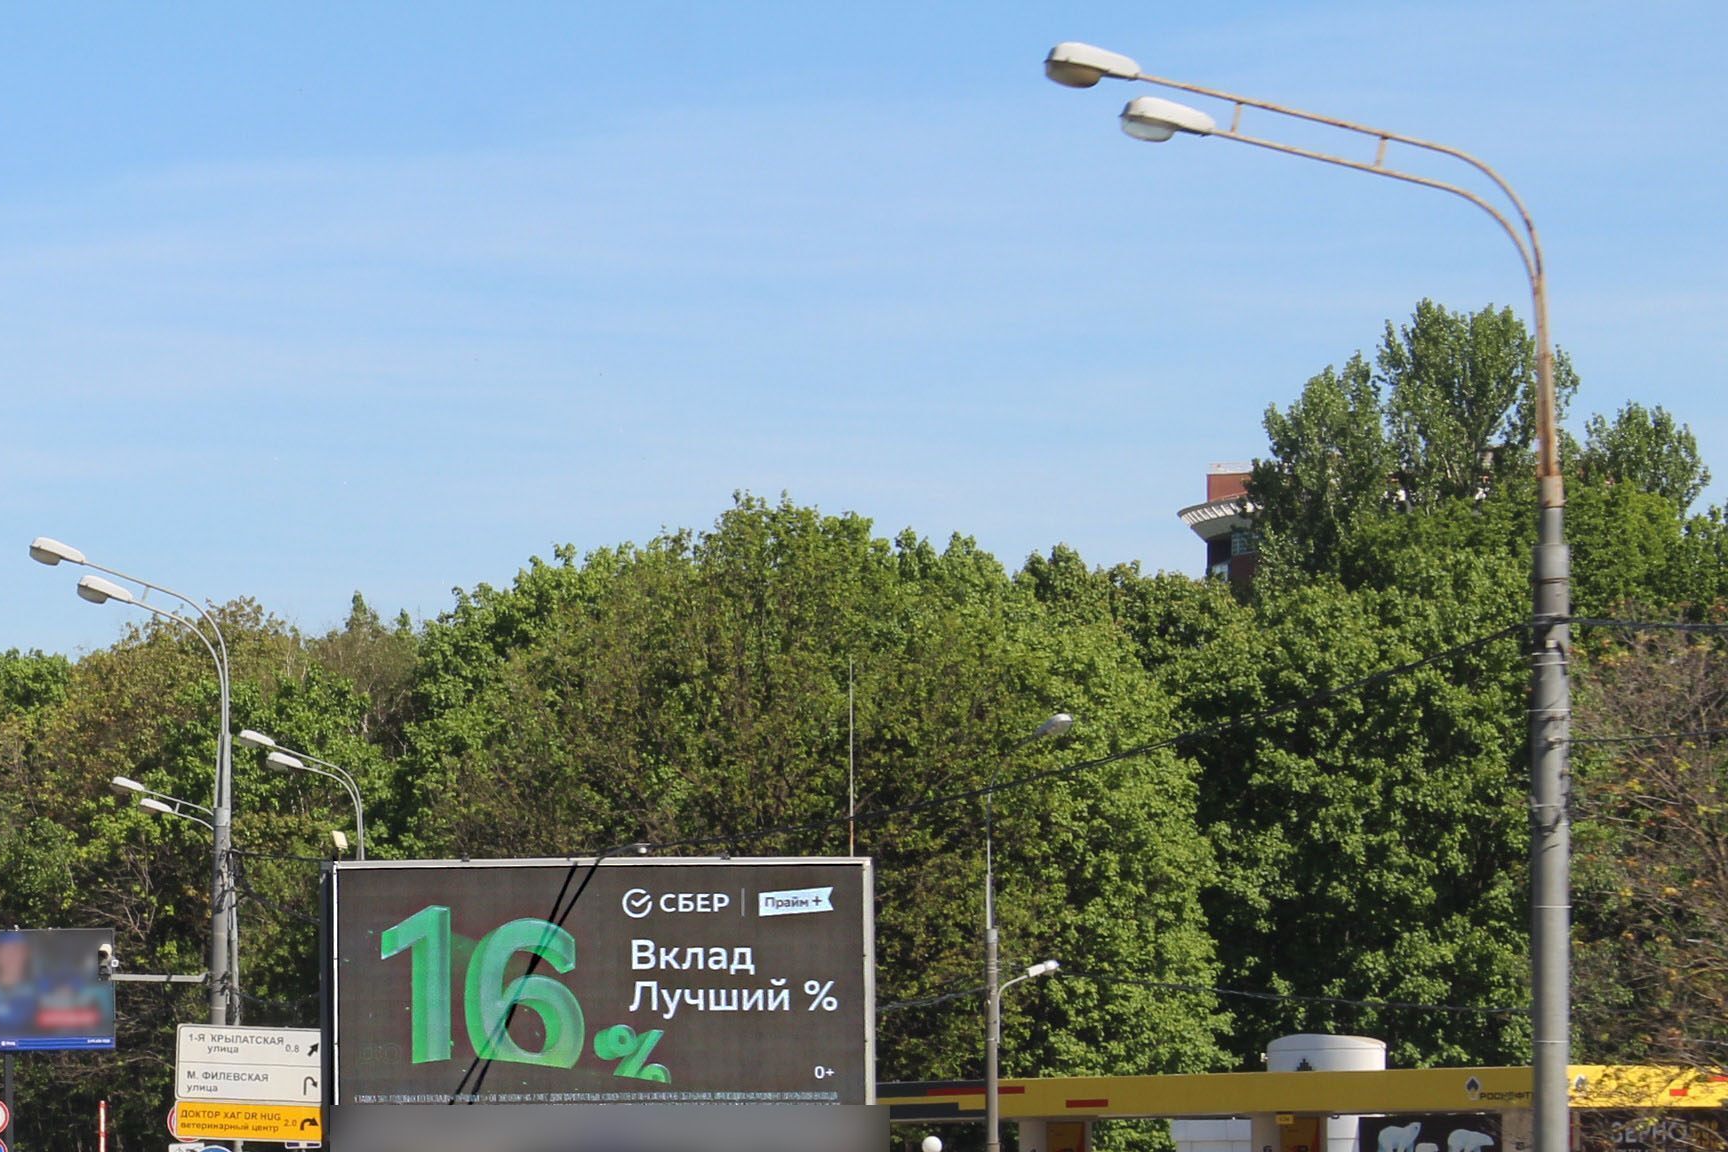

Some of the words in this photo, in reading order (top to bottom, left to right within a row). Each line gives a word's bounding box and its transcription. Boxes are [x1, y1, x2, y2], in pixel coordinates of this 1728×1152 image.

[660, 893, 730, 913] СБЕР
[631, 939, 756, 975] Вклад
[629, 978, 790, 1020] Лучший
[804, 980, 838, 1012] %
[188, 1033, 205, 1042] 1-Я
[210, 1034, 284, 1045] КРЫЛАТСКАЯ
[207, 1044, 239, 1054] улица
[187, 1071, 199, 1080] М.
[202, 1071, 269, 1082] ФИЛЕВСКАЯ
[814, 1065, 835, 1079] 0+
[186, 1083, 218, 1093] улица
[180, 1109, 221, 1119] ДОКТОР
[224, 1111, 241, 1120] ХАГ
[244, 1112, 258, 1120] DR
[260, 1113, 281, 1121] HUG
[180, 1122, 249, 1131] ветеринарный
[252, 1125, 279, 1133] центр
